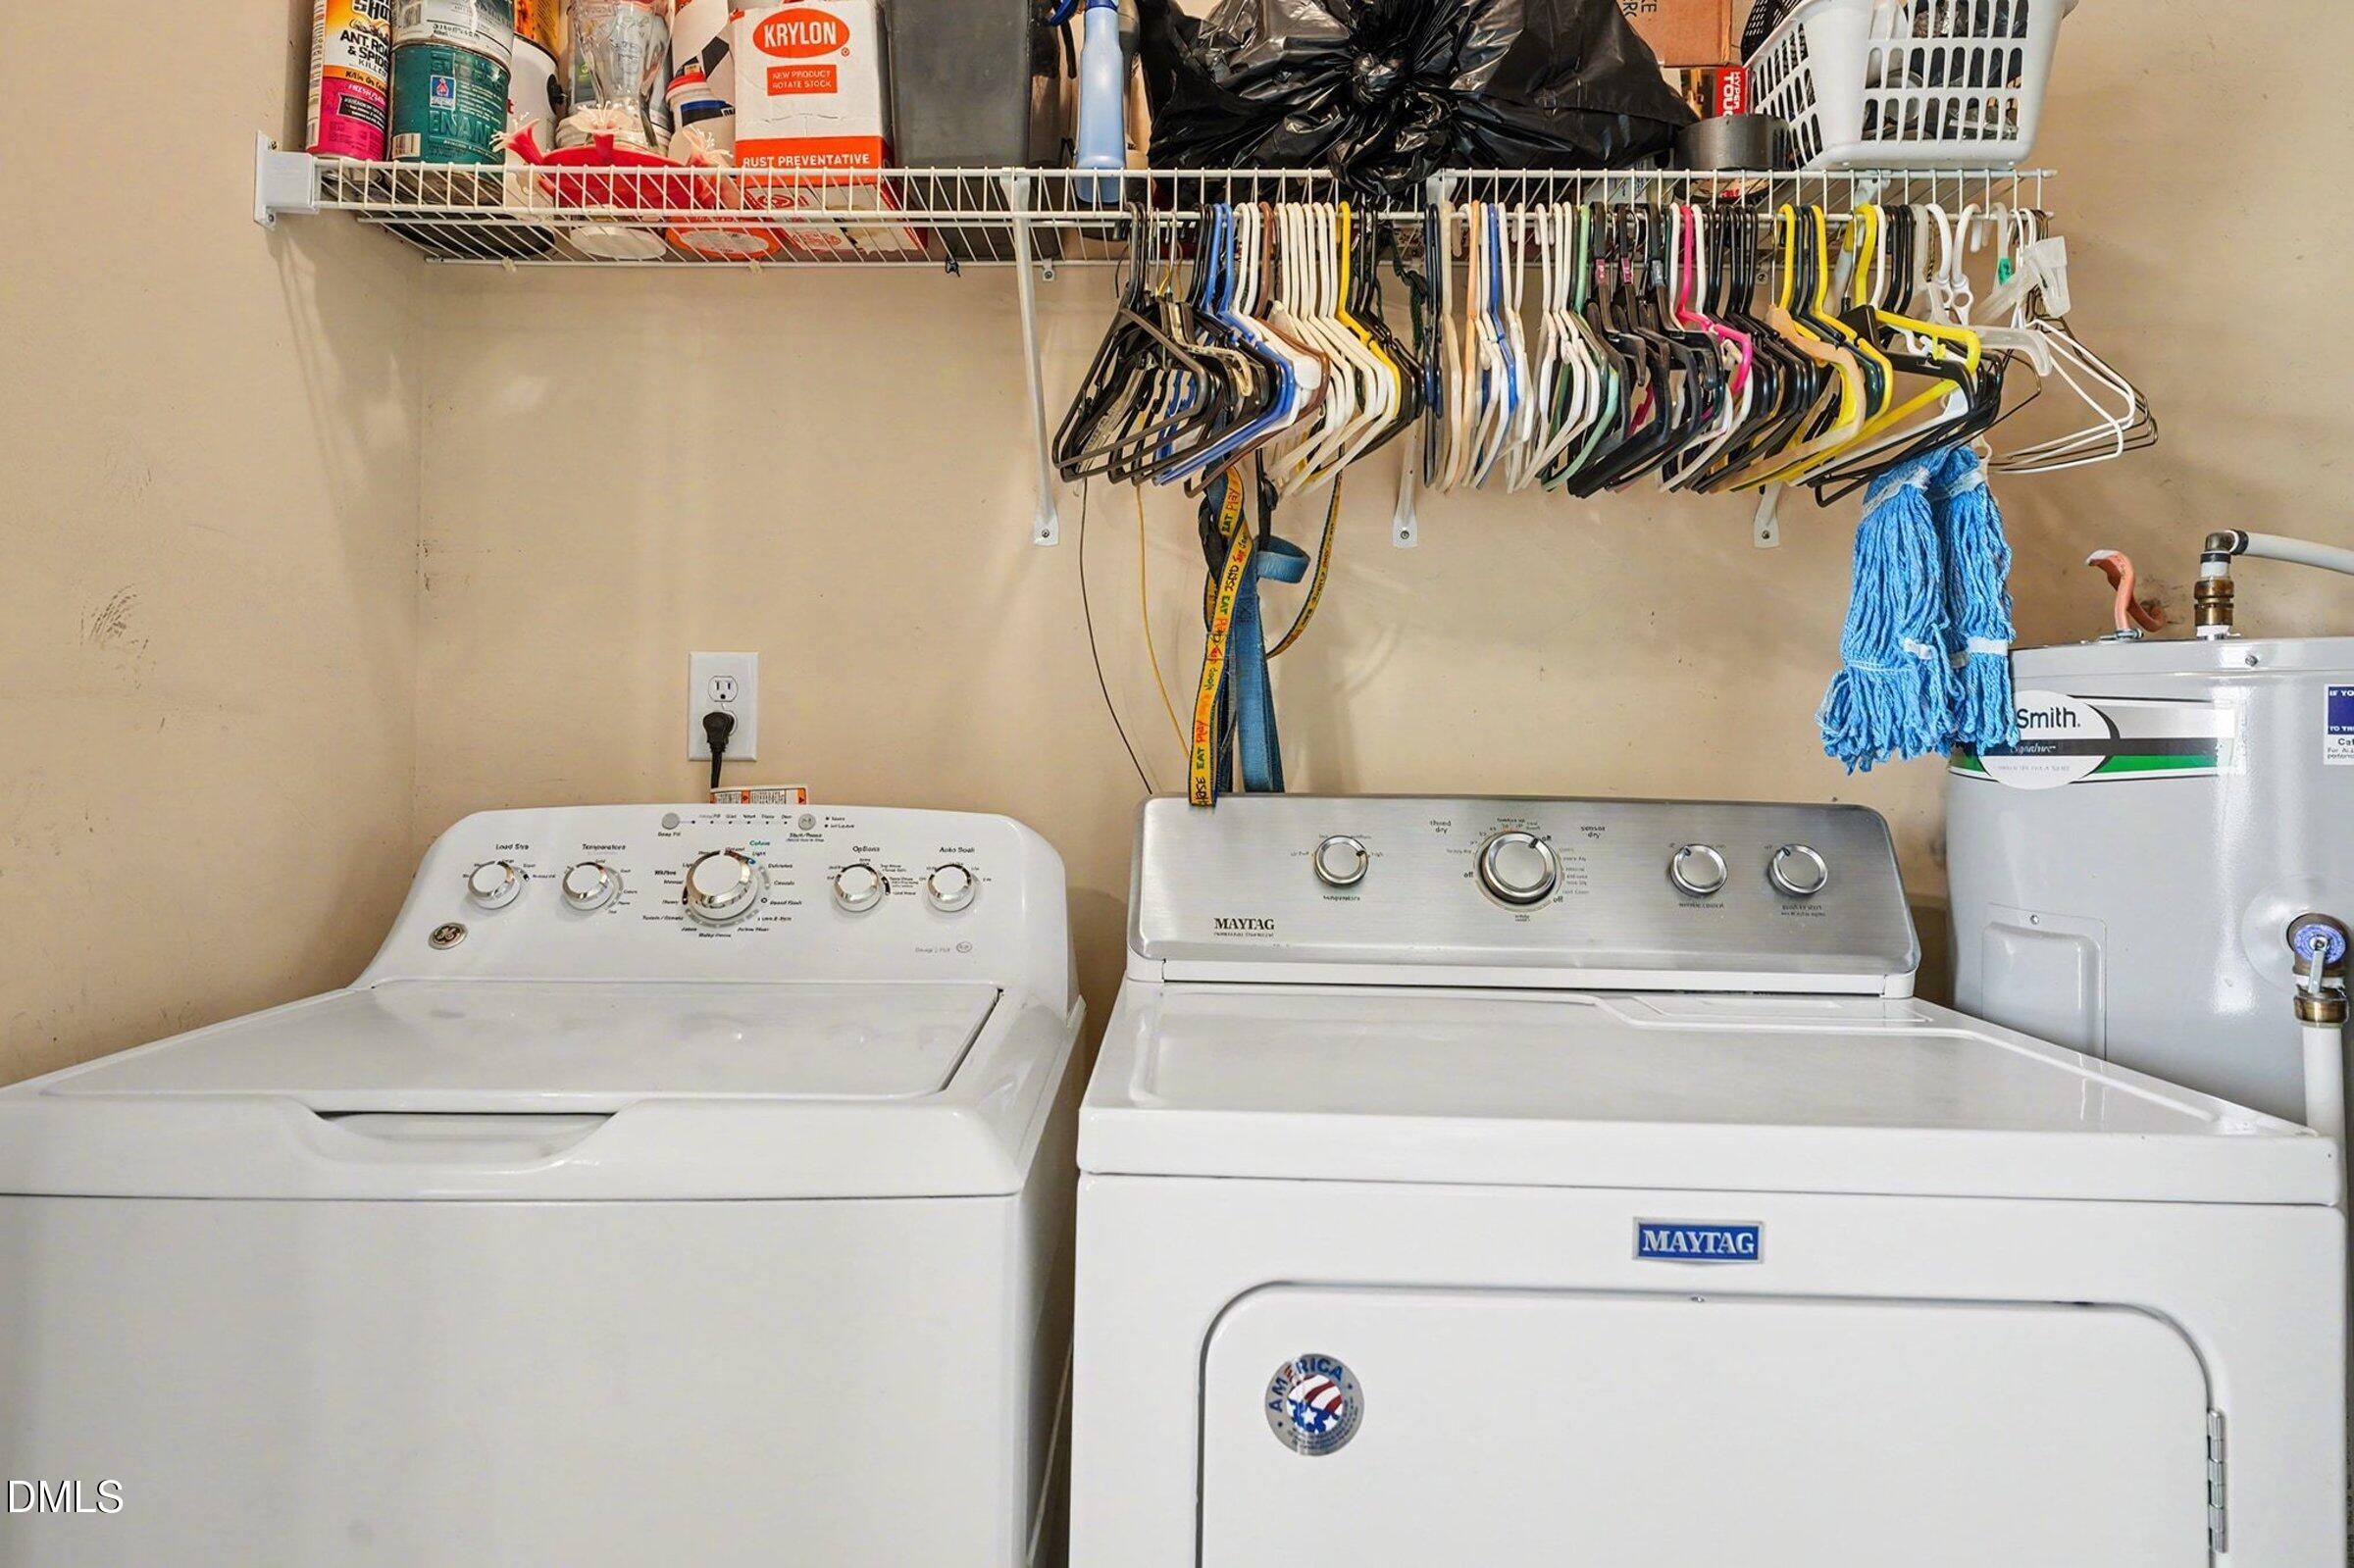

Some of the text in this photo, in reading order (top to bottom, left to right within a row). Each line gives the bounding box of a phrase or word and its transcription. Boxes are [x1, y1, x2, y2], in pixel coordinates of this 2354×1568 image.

[764, 21, 837, 48] KRYLON
[772, 70, 832, 80] NEW PRODUCT
[772, 79, 832, 90] ROTATE STOCK
[742, 152, 870, 168] RUST PREVENTATIVE
[1213, 917, 1275, 930] MAYTAG
[1642, 1229, 1755, 1254] MAYTAG
[1268, 1357, 1343, 1413] AMERICA
